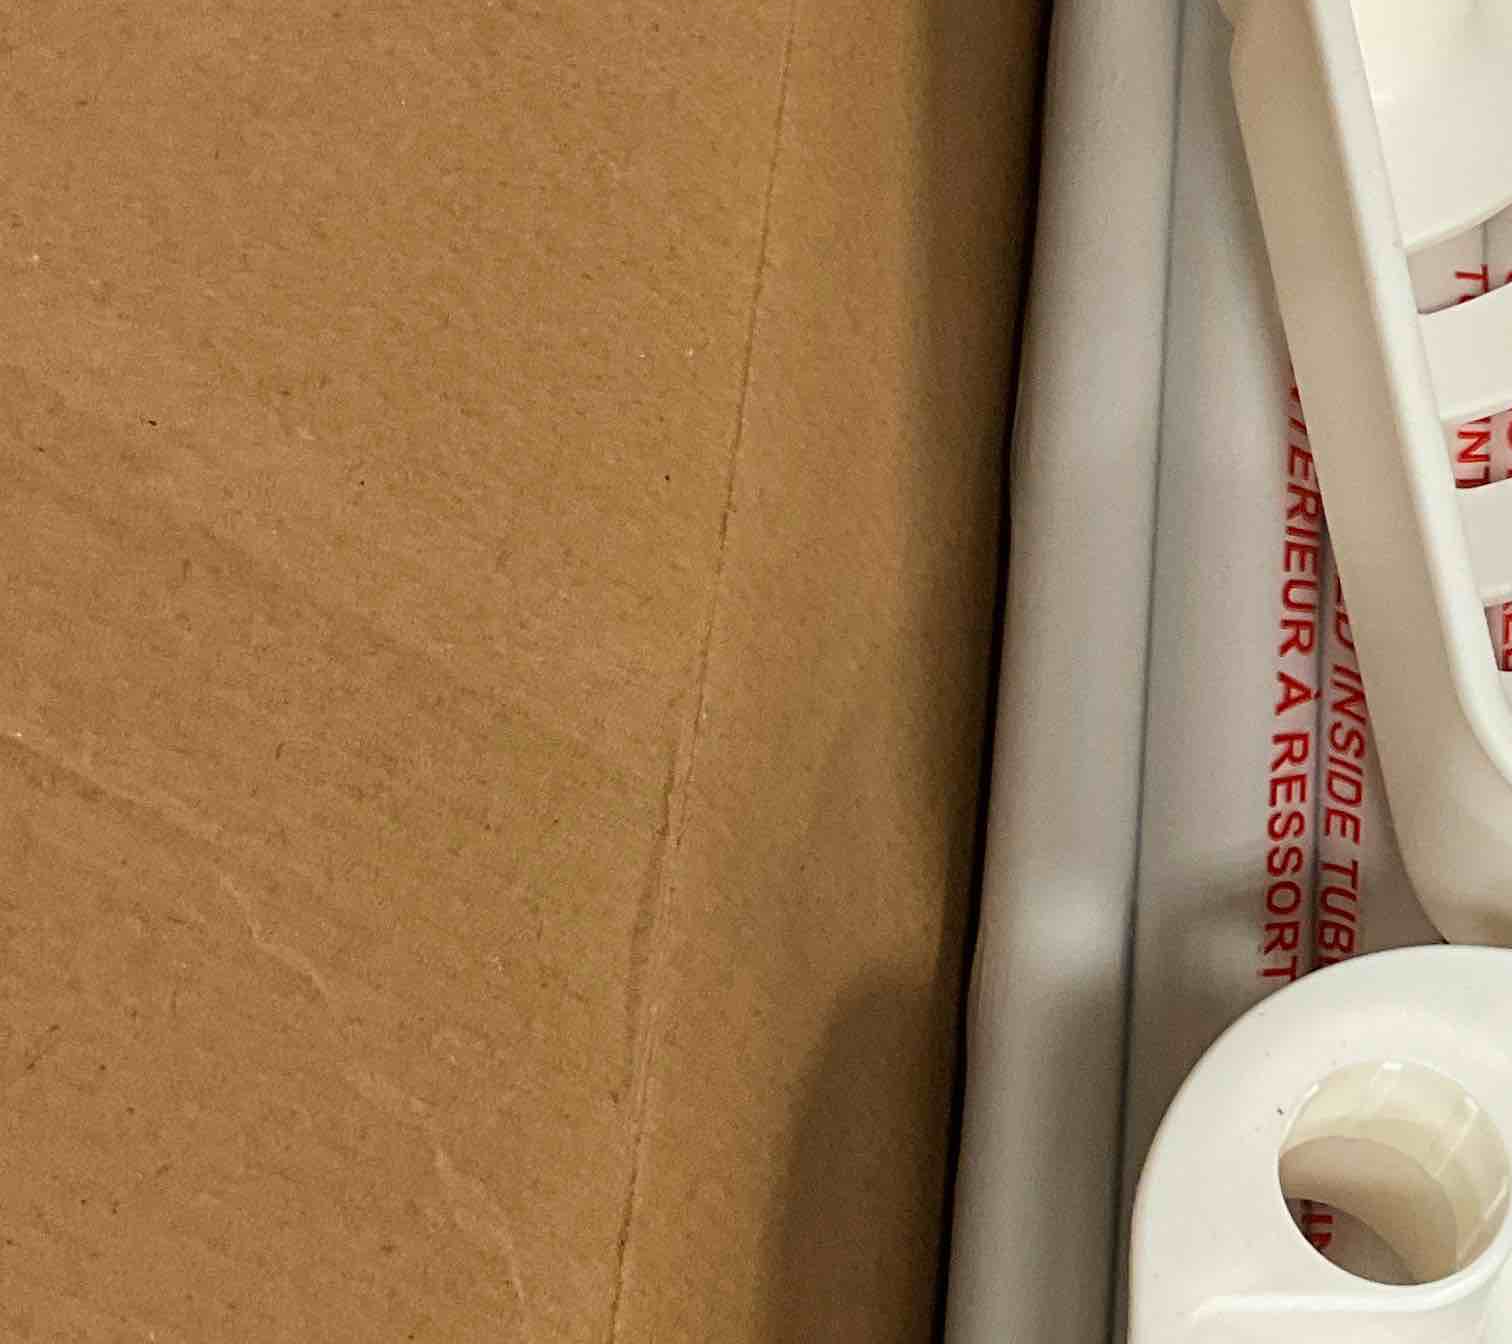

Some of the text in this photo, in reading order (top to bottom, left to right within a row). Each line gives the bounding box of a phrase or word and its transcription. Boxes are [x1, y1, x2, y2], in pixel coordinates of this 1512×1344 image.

[1323, 662, 1368, 846] INSIDE
[1258, 731, 1311, 983] RESSORT
[1316, 859, 1359, 967] TUB
